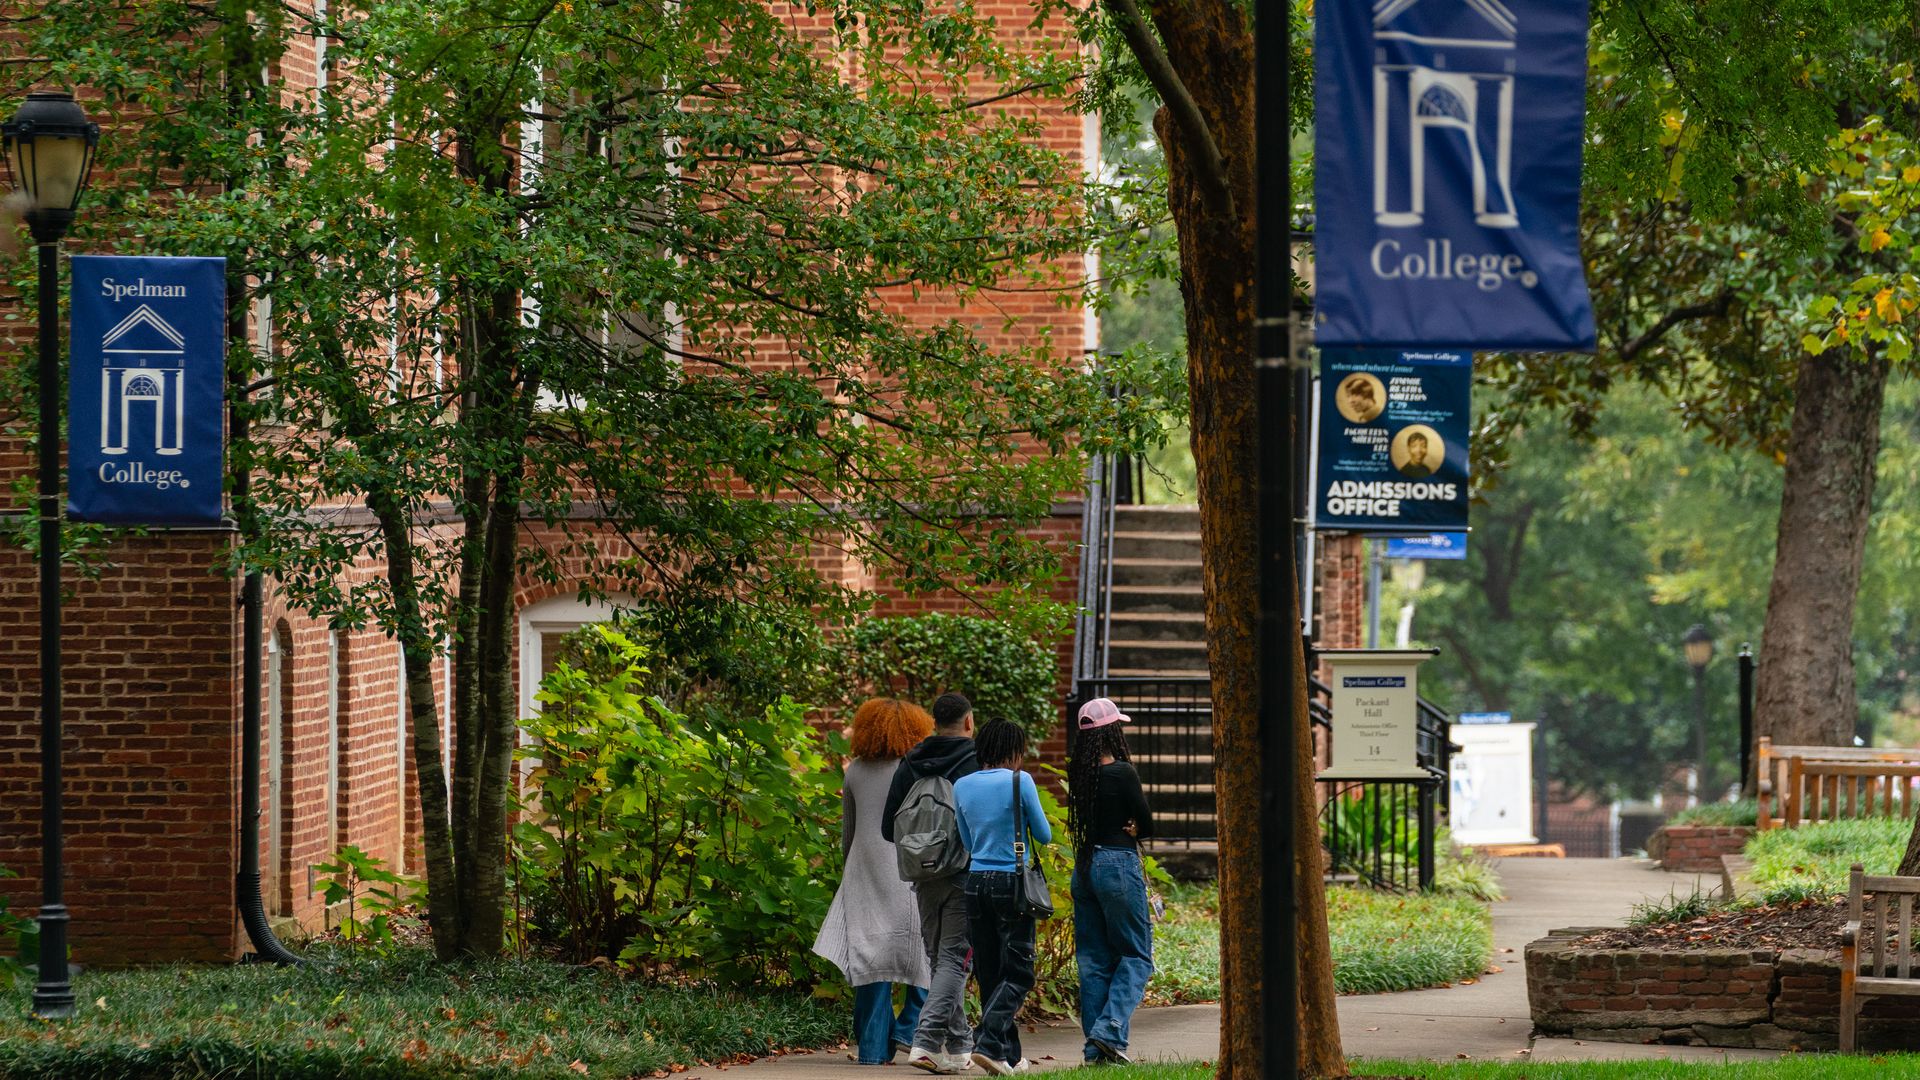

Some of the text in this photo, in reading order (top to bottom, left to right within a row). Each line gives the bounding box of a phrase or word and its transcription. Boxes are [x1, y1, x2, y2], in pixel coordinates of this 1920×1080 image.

[1371, 238, 1523, 291] College
[101, 278, 187, 302] Spelman
[1402, 352, 1461, 362] Spelman College
[99, 461, 182, 490] College
[1327, 480, 1457, 501] ADMISSIONS
[1327, 498, 1401, 517] OFFICE
[1344, 678, 1405, 688] Spelman College
[1355, 697, 1390, 707] Packard
[1364, 708, 1383, 718] Hall
[1368, 745, 1381, 755] 14
